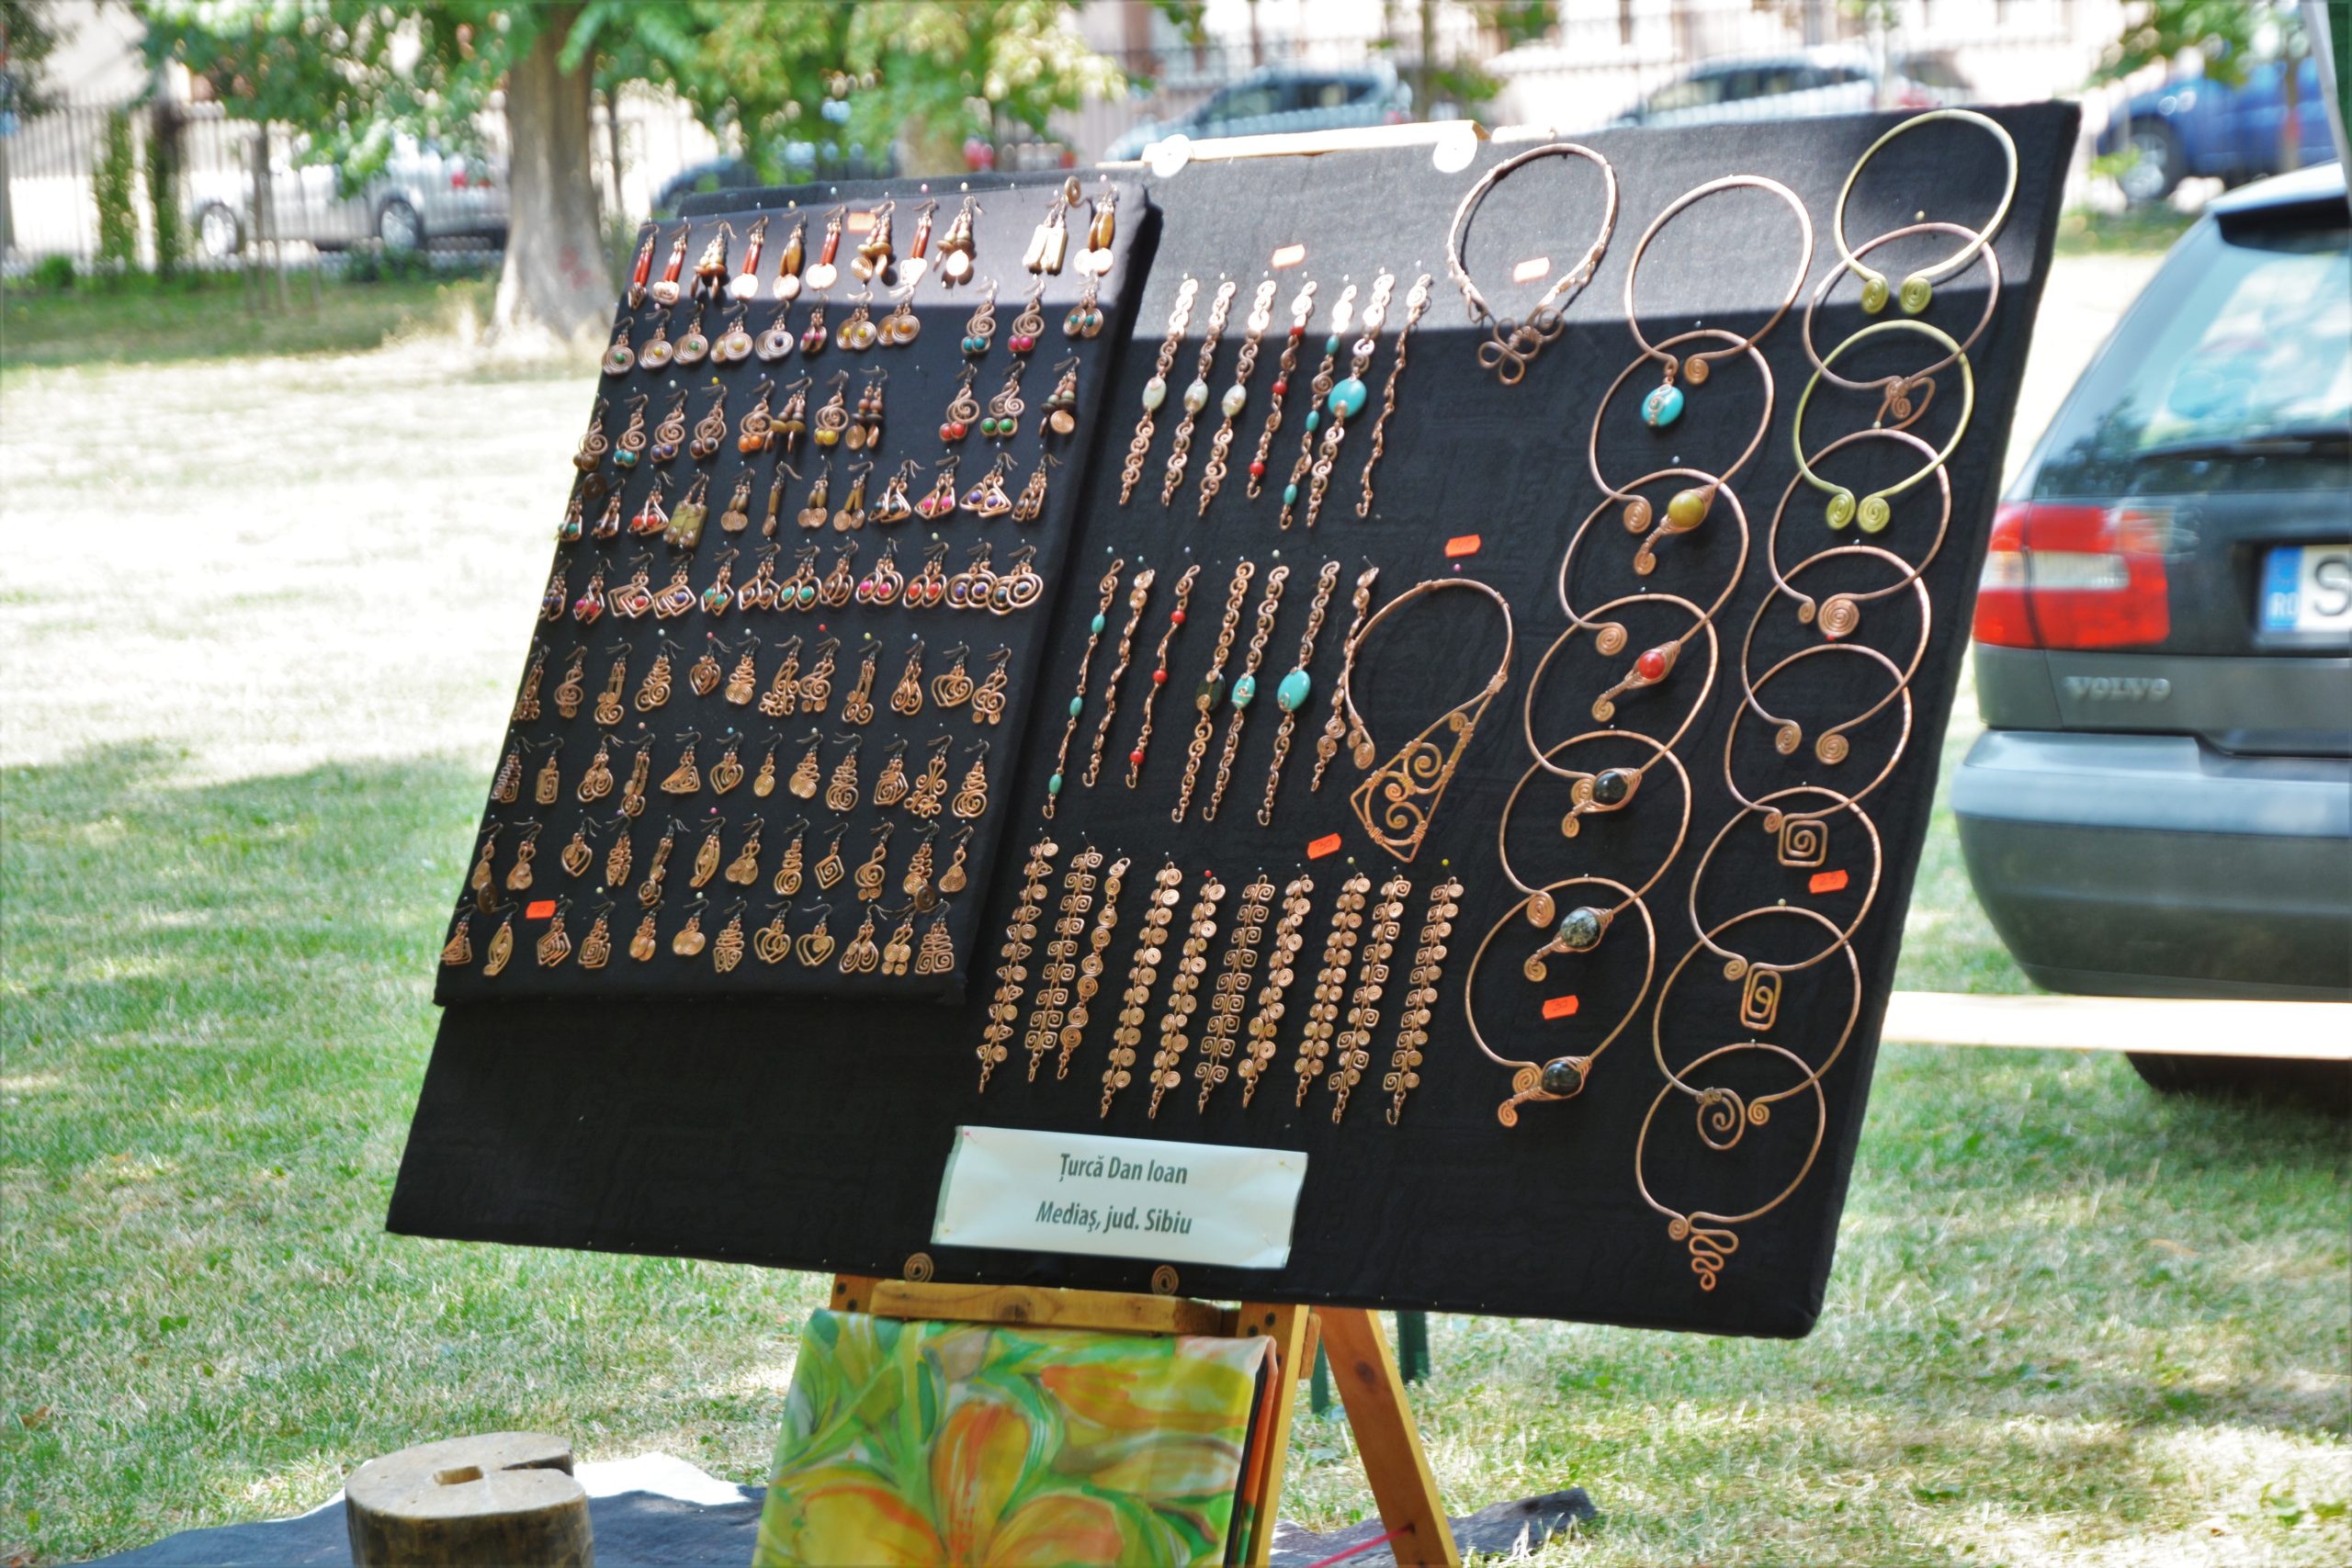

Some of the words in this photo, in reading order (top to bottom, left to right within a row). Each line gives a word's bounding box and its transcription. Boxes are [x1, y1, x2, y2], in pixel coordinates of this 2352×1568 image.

[2313, 555, 2352, 617] S
[2064, 675, 2172, 701] VOLVO
[1107, 1156, 1143, 1180] Dan
[1147, 1159, 1188, 1184] Ioan
[1102, 1205, 1139, 1234] jud.
[1144, 1208, 1193, 1235] Sibiu
